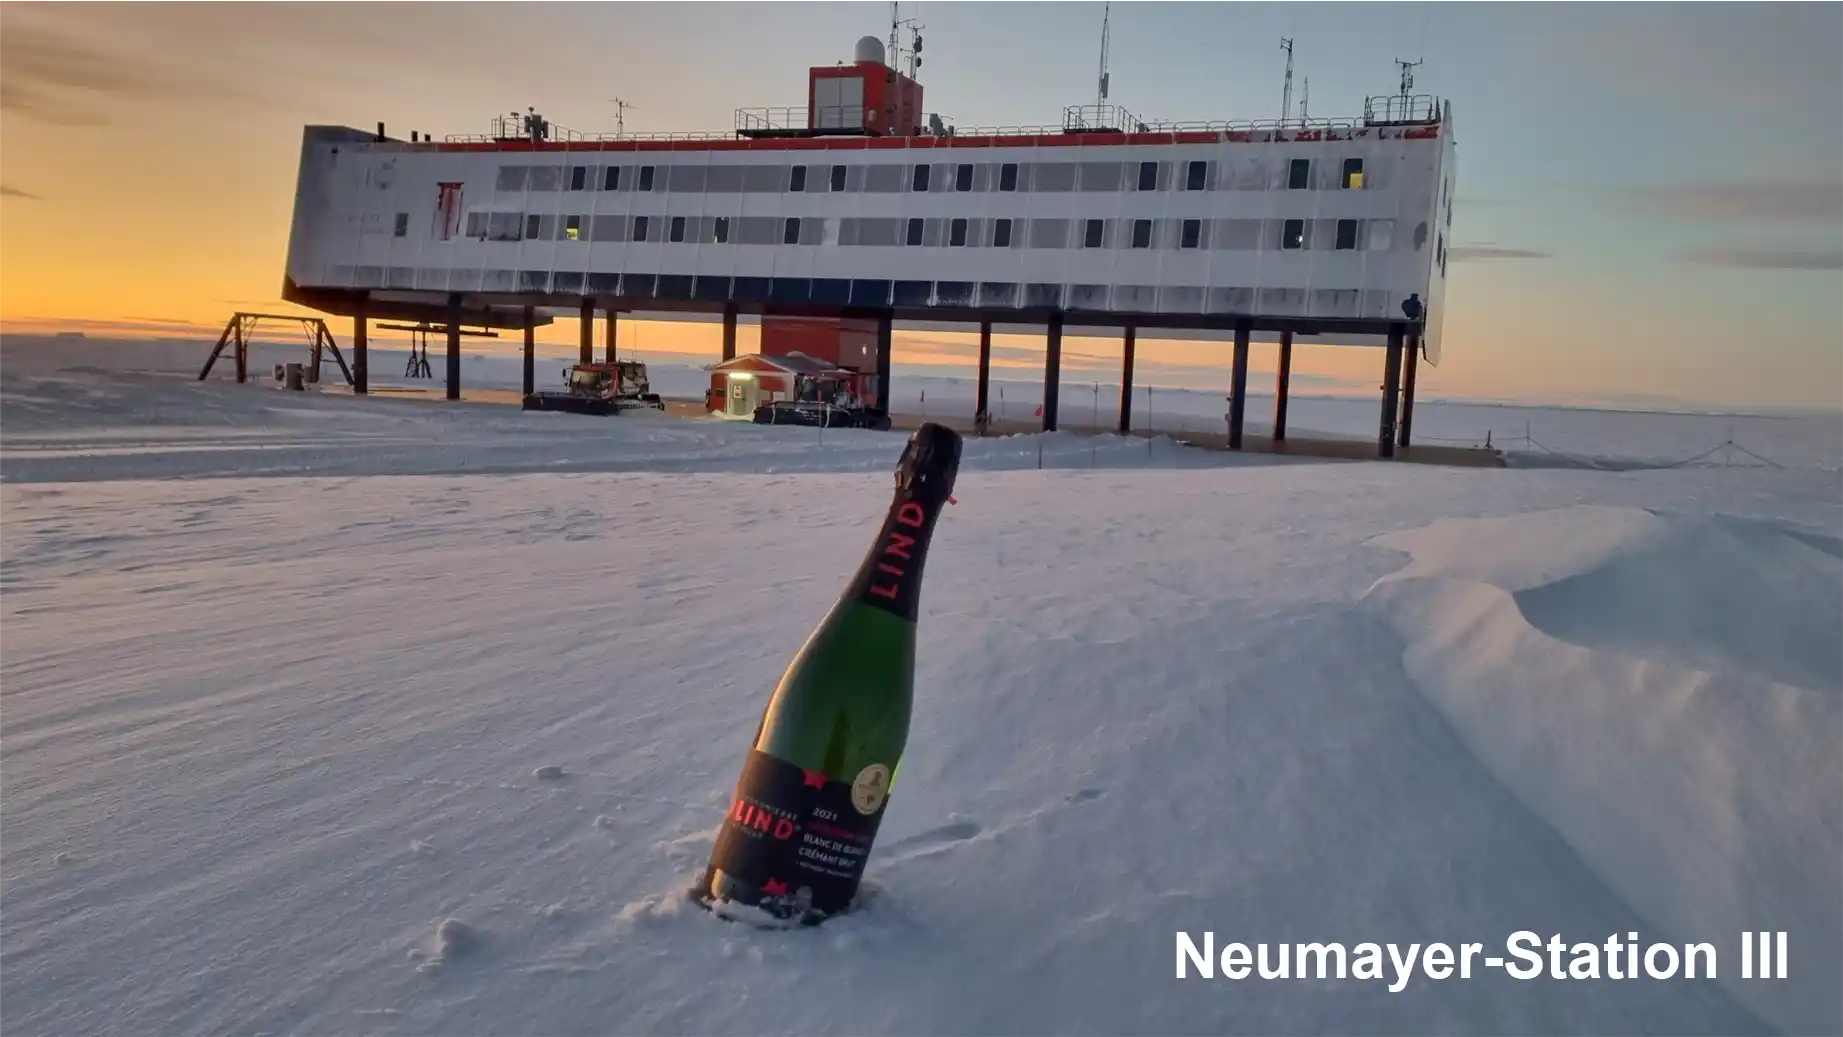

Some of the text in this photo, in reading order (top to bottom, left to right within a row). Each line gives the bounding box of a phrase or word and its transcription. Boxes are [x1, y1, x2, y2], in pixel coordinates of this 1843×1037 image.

[870, 502, 925, 600] LIND
[734, 799, 793, 840] LIND
[812, 807, 838, 821] 2021
[803, 832, 831, 849] BLANC
